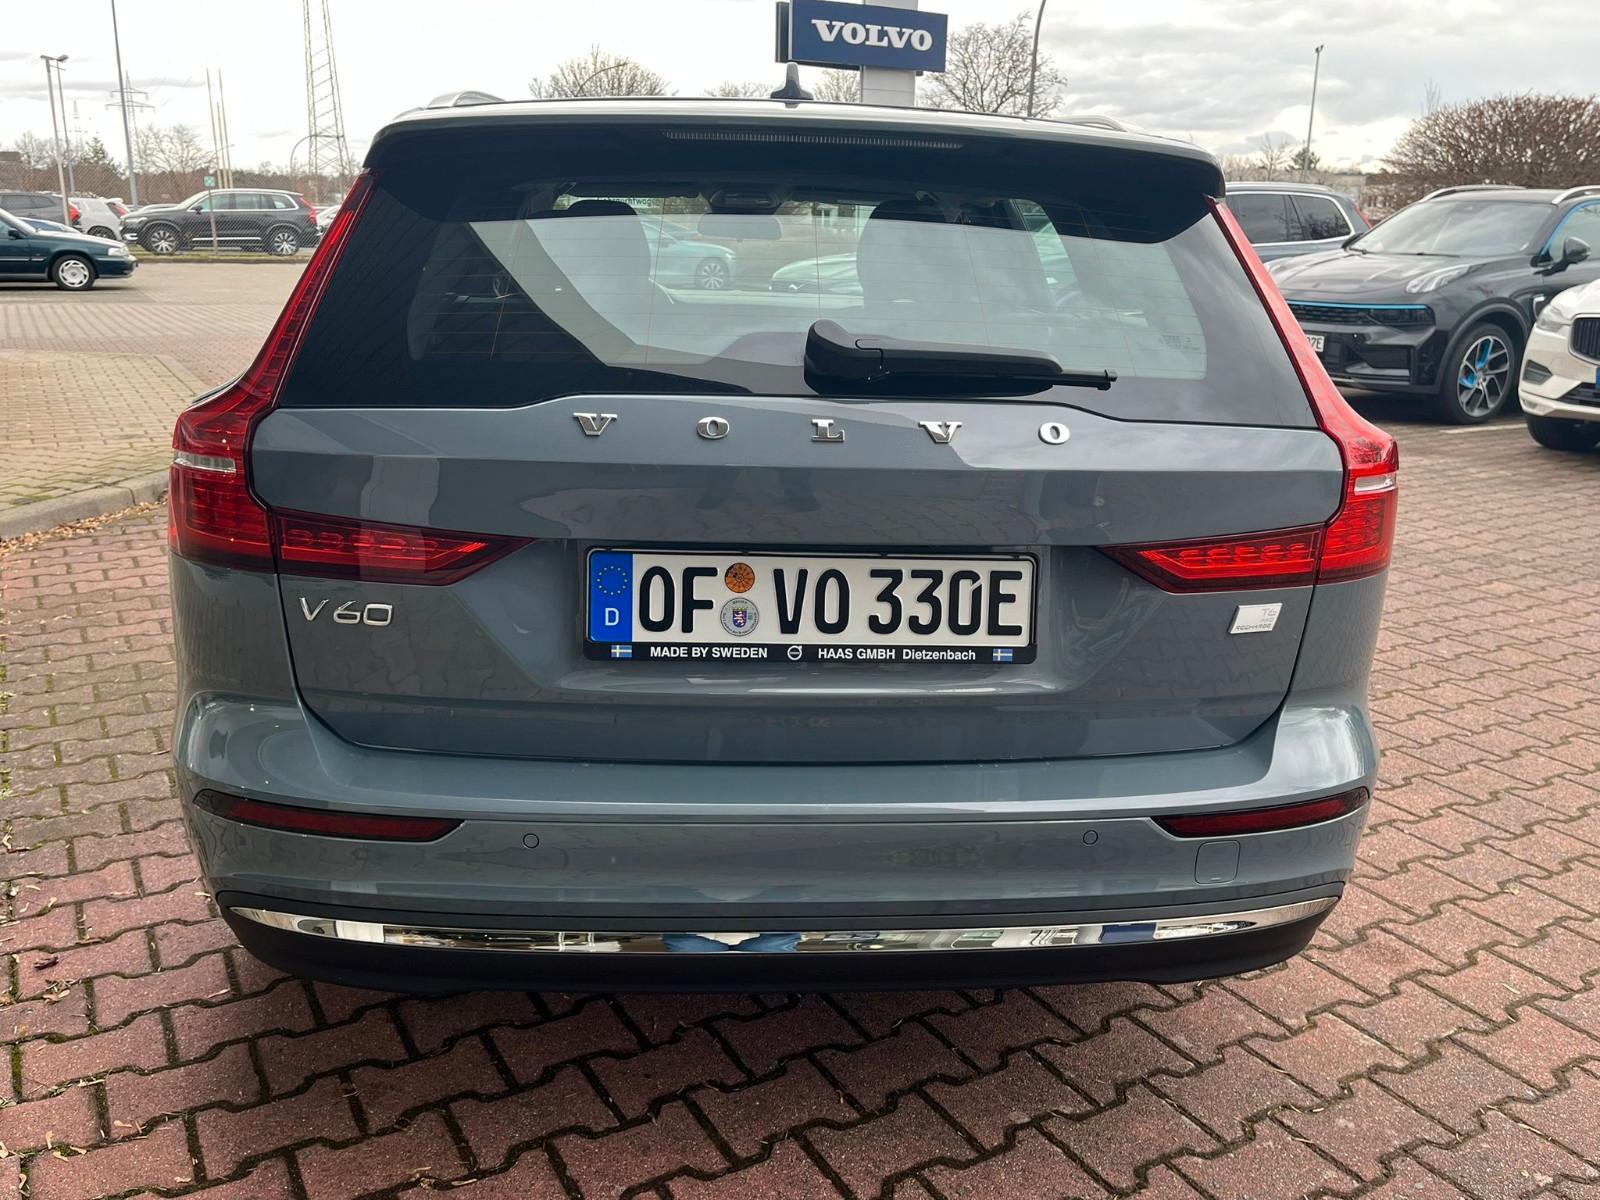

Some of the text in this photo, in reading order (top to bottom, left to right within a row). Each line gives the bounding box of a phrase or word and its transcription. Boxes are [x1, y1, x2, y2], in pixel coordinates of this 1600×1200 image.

[811, 19, 933, 51] VOLVO
[573, 412, 1071, 445] VOLVO
[639, 565, 718, 633] OF
[773, 568, 850, 634] VO
[868, 569, 1023, 636] 330E
[604, 607, 620, 626] D
[650, 646, 768, 658] MADE BY SWEDEN
[818, 647, 976, 660] HAAS GMBH Dietzenbach
